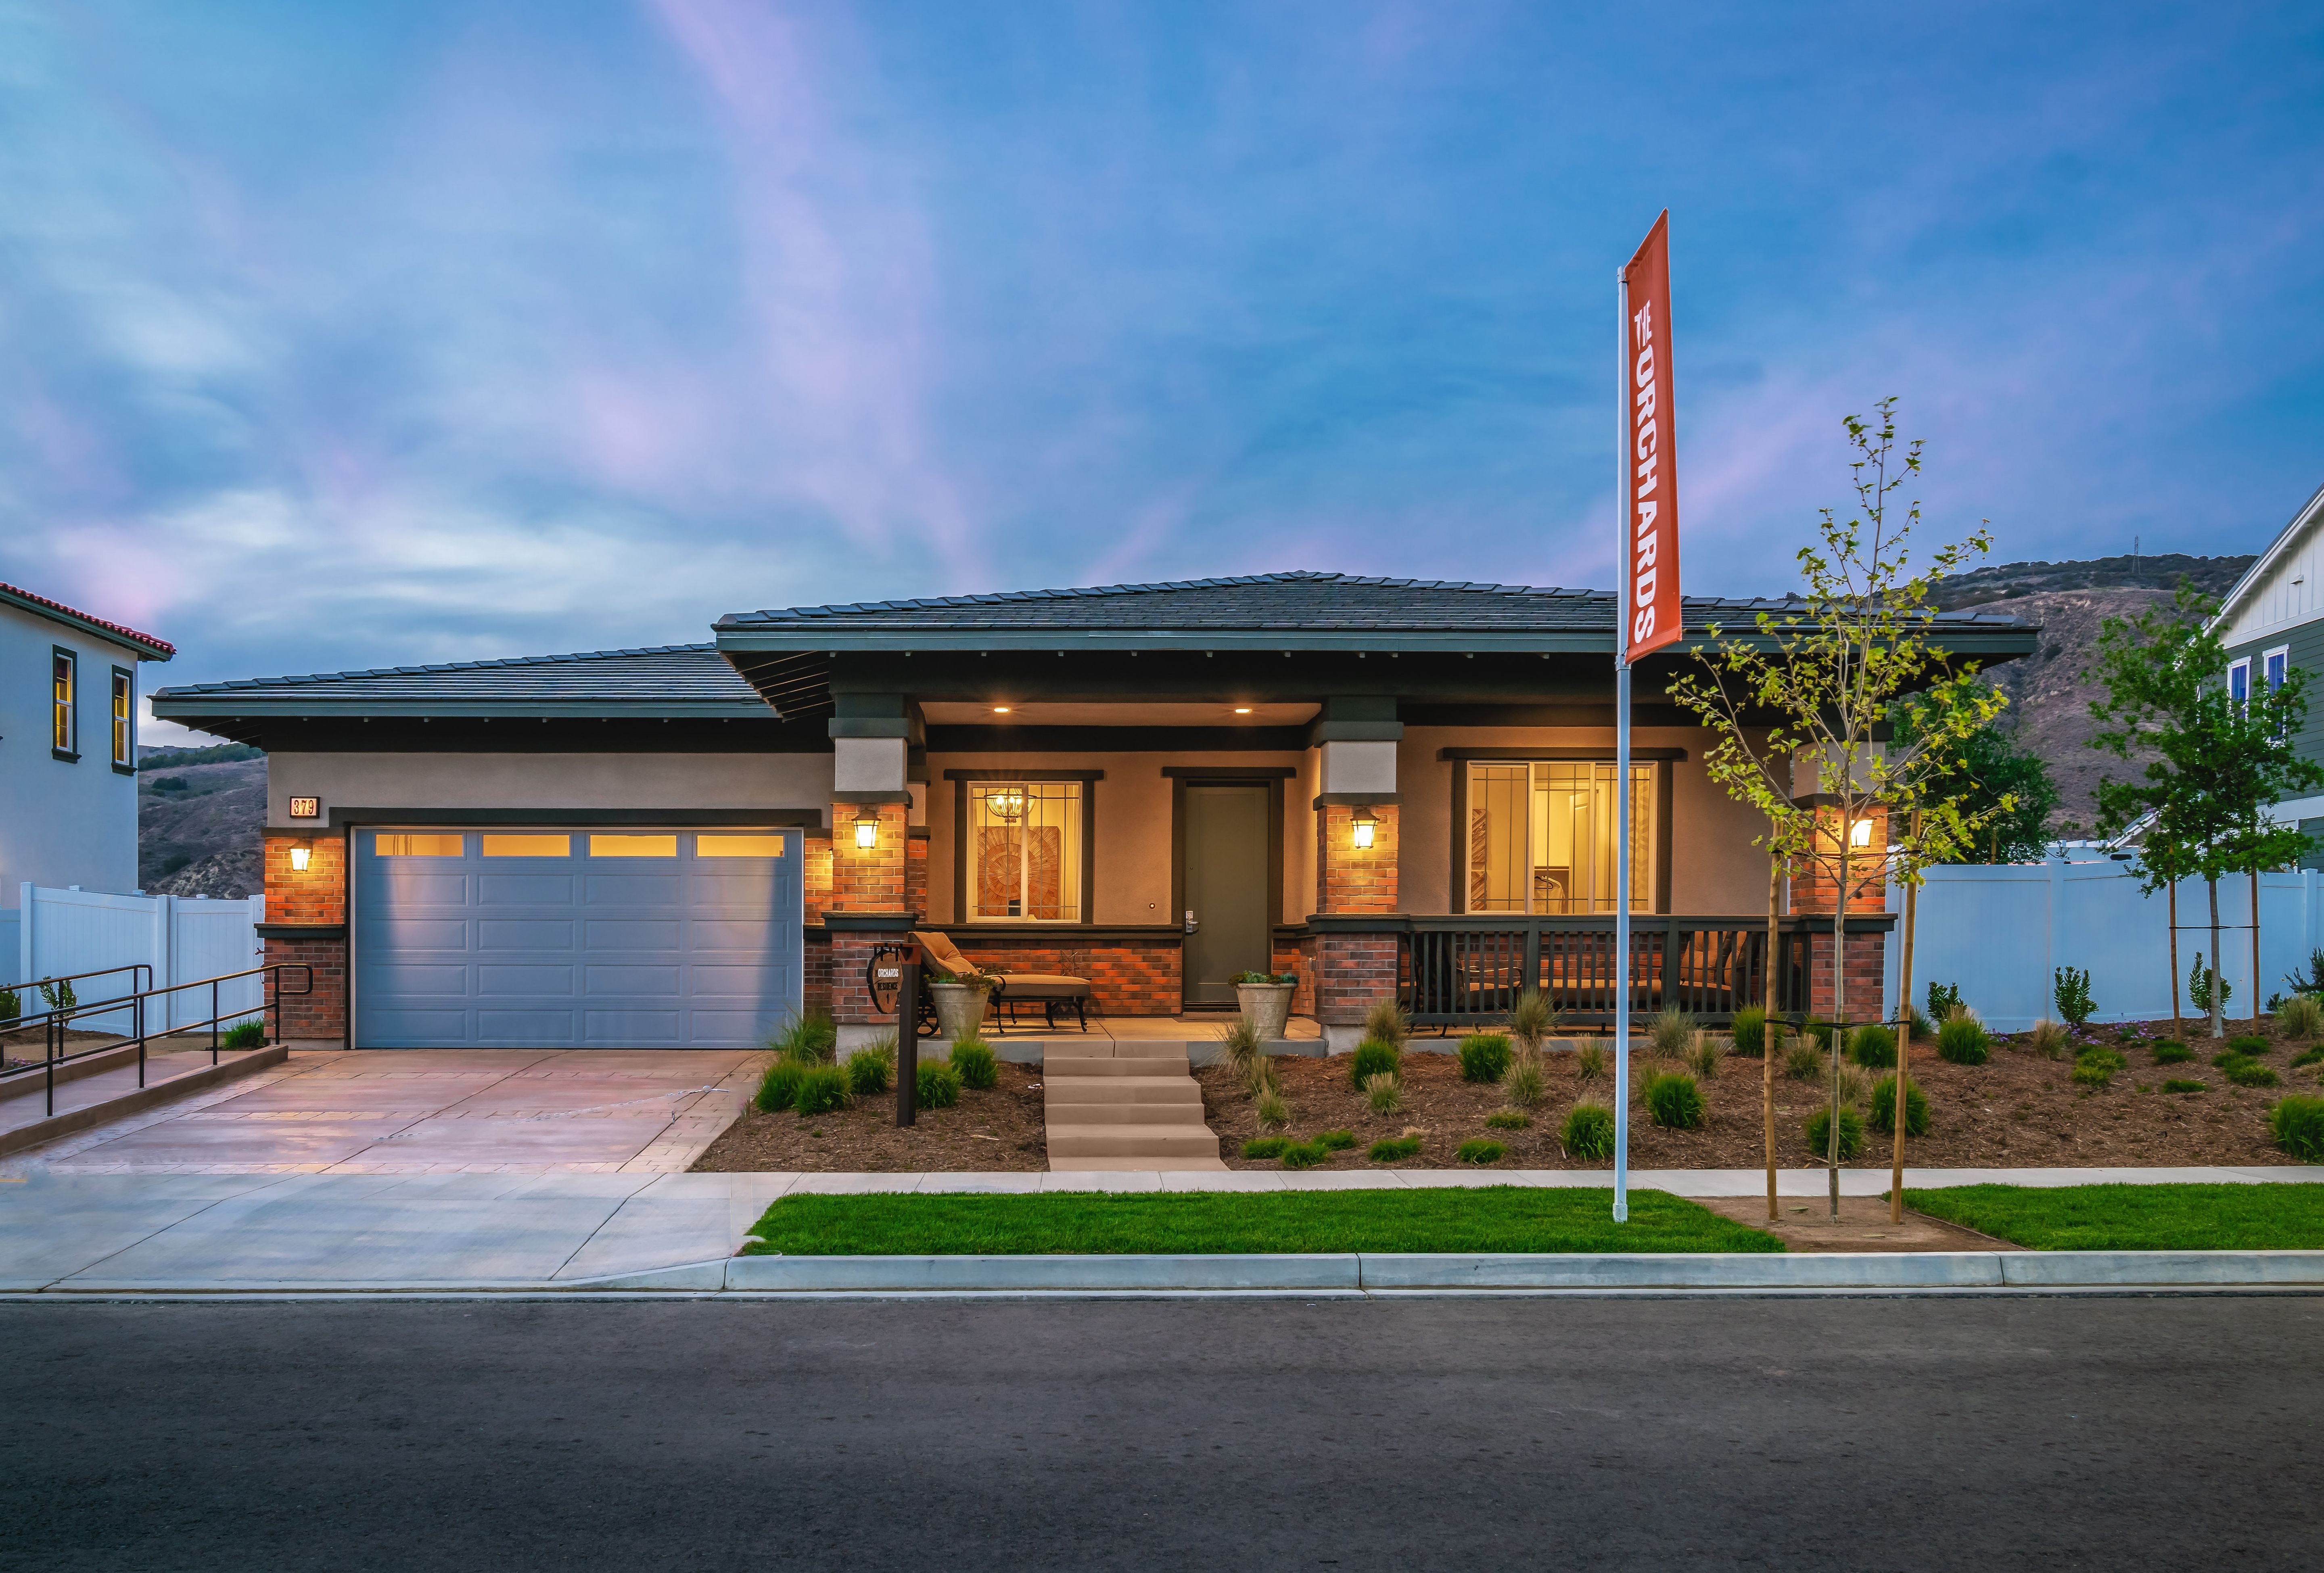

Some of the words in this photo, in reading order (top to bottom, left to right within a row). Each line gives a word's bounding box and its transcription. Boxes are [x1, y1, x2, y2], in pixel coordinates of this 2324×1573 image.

[1634, 299, 1652, 351] THE
[1634, 345, 1657, 644] ORCHARDS
[294, 800, 313, 814] 379
[878, 968, 899, 977] ORCHARDS
[878, 982, 898, 991] RESIDENCE
[886, 993, 889, 1004] 1
